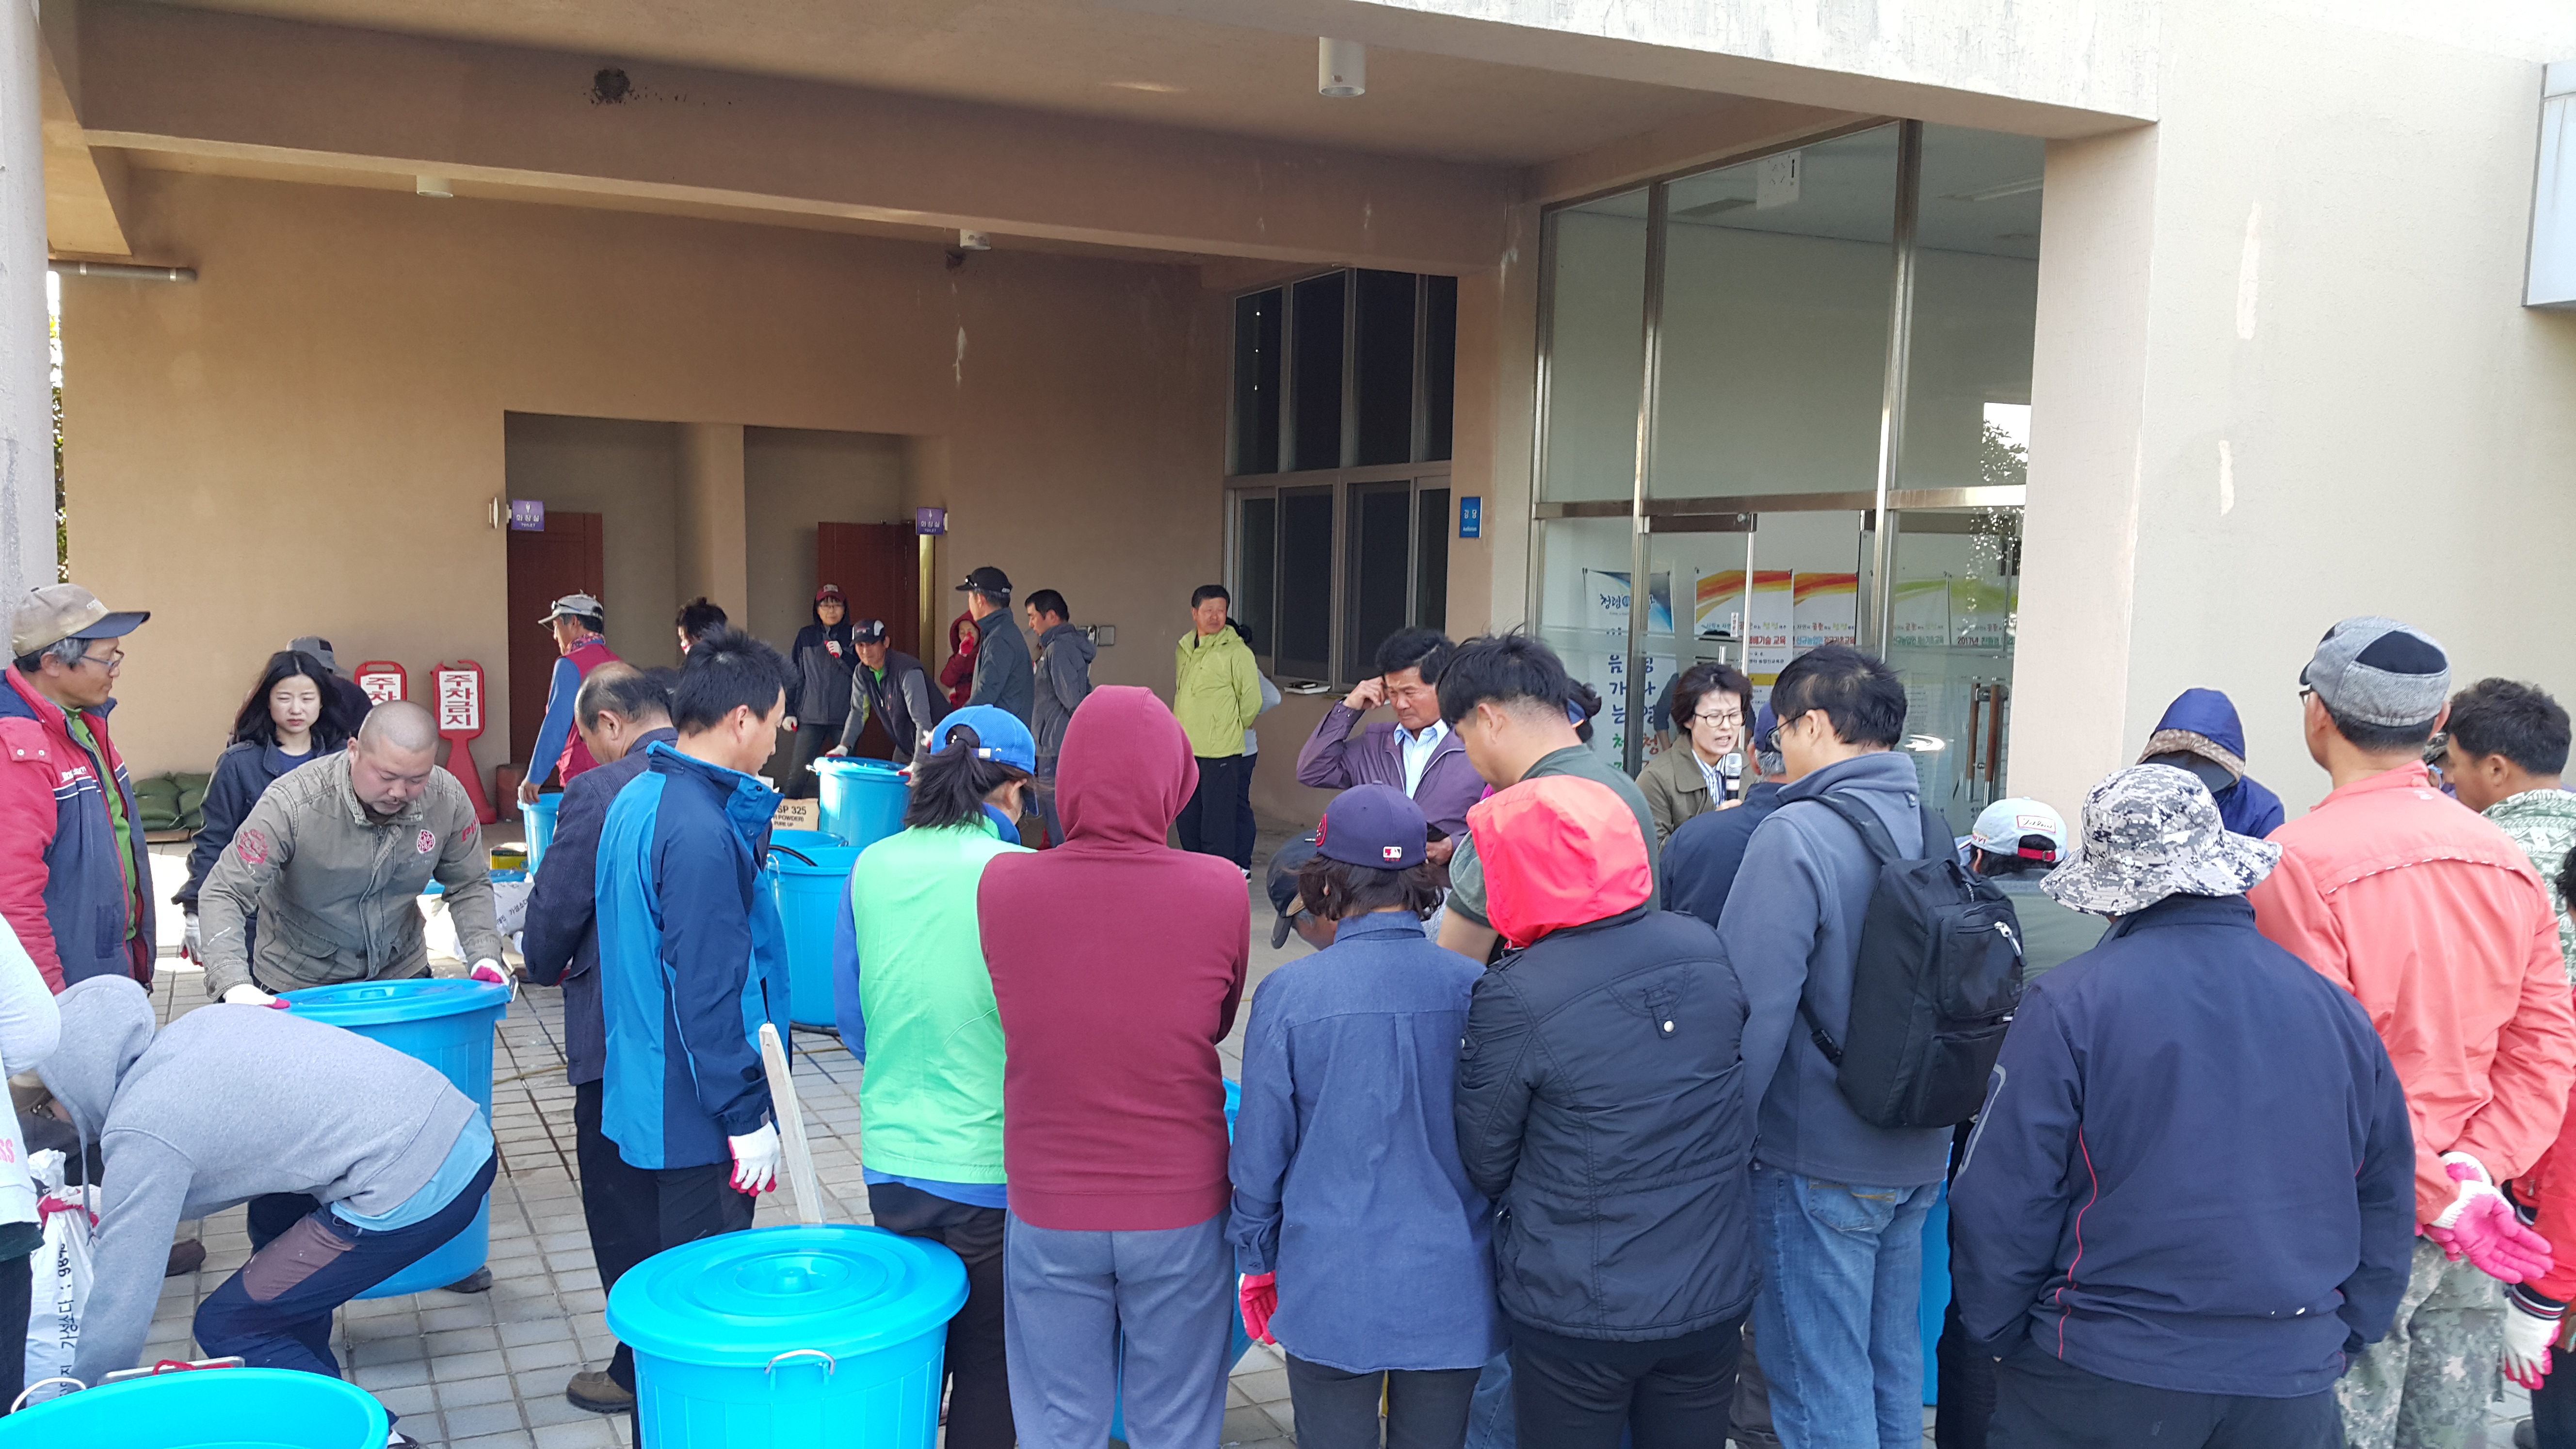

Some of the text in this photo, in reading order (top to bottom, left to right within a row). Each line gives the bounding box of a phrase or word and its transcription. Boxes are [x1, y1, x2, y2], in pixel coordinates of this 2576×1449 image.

[516, 514, 539, 522] 화장실
[1464, 509, 1477, 519] 강당
[1957, 636, 1979, 645] 2017년
[444, 675, 474, 726] 주차금지
[791, 806, 806, 815] 325
[58, 1300, 78, 1349] 가성소다
